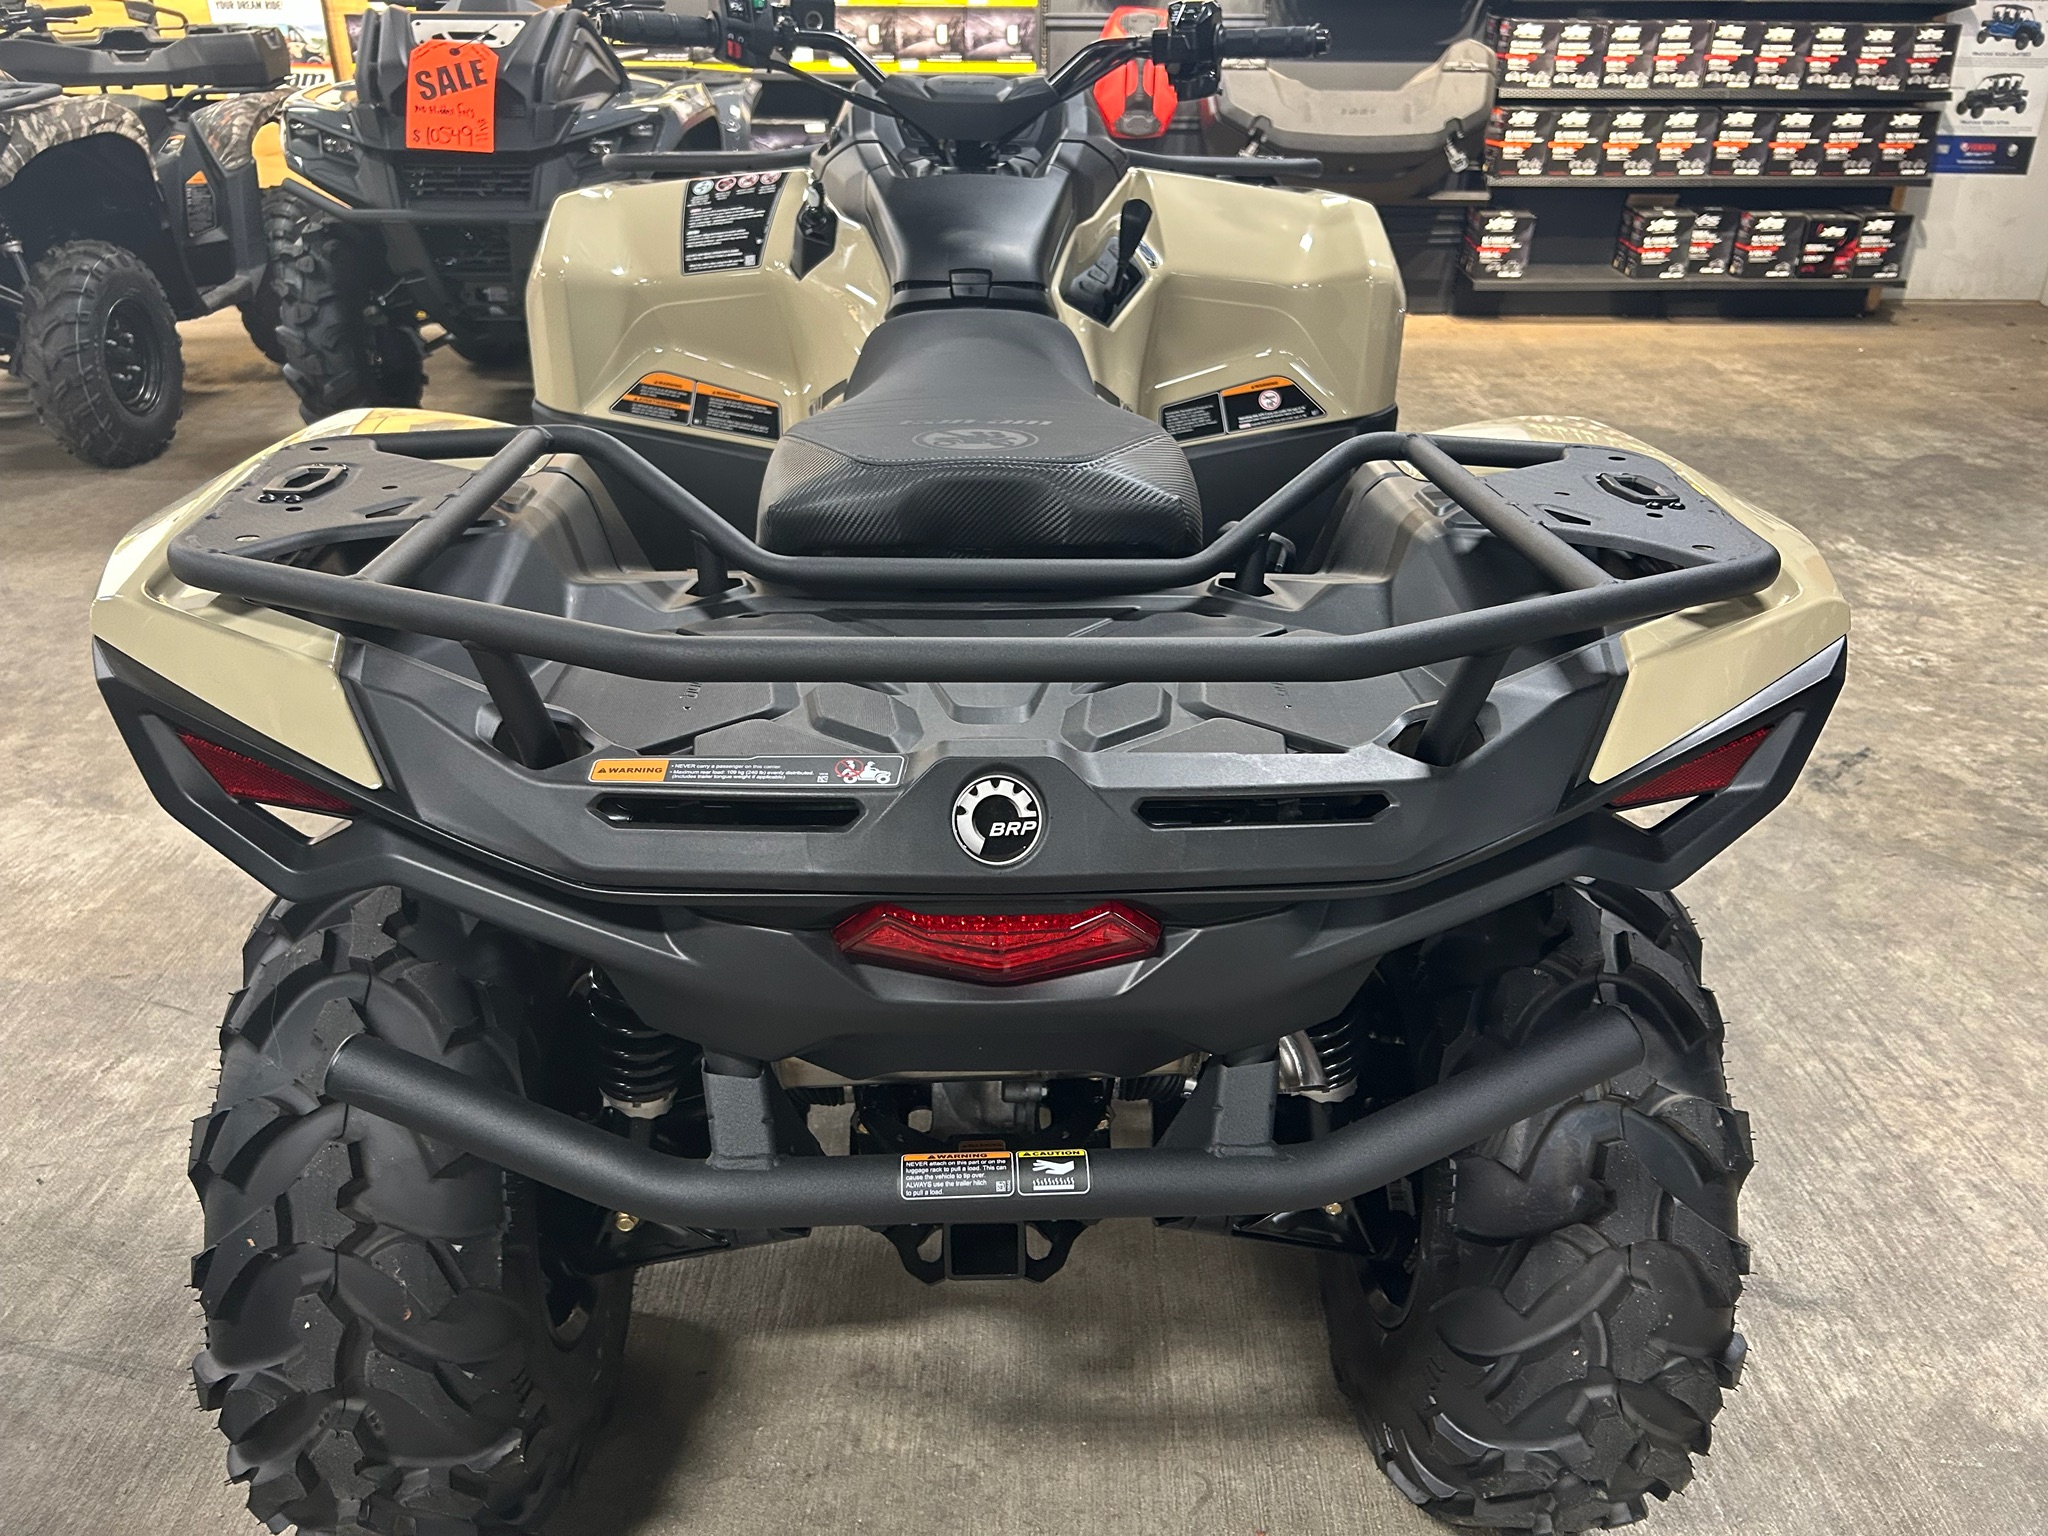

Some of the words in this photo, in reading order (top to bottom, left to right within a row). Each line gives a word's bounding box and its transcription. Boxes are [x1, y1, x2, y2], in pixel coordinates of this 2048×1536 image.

[415, 59, 489, 101] SALE
[988, 820, 1038, 837] BRP
[905, 1167, 929, 1175] luggage
[963, 1172, 971, 1180] tip
[905, 1181, 932, 1189] ALWAYS
[912, 1189, 924, 1197] pull
